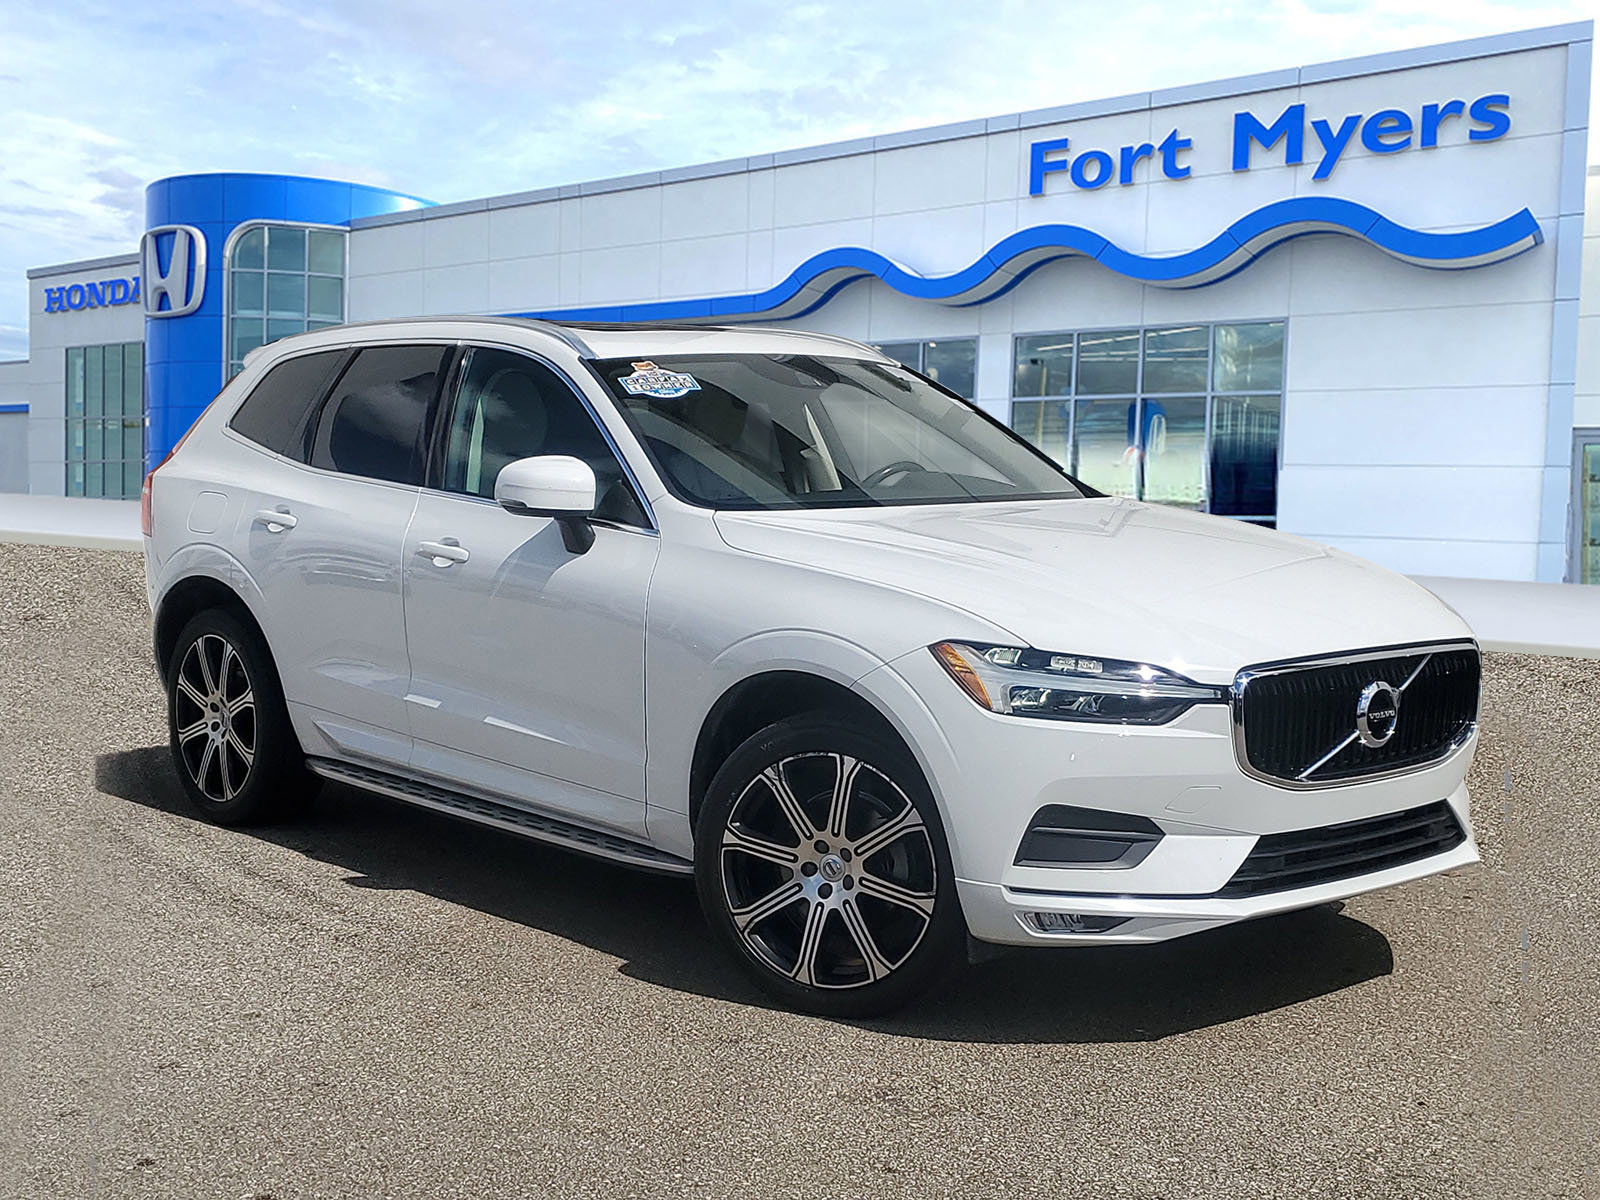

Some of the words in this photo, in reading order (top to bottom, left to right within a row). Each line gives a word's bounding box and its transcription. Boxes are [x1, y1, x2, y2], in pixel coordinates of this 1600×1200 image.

[1028, 128, 1192, 197] Fort
[1231, 93, 1511, 182] Myers
[1369, 710, 1395, 719] VOLVO
